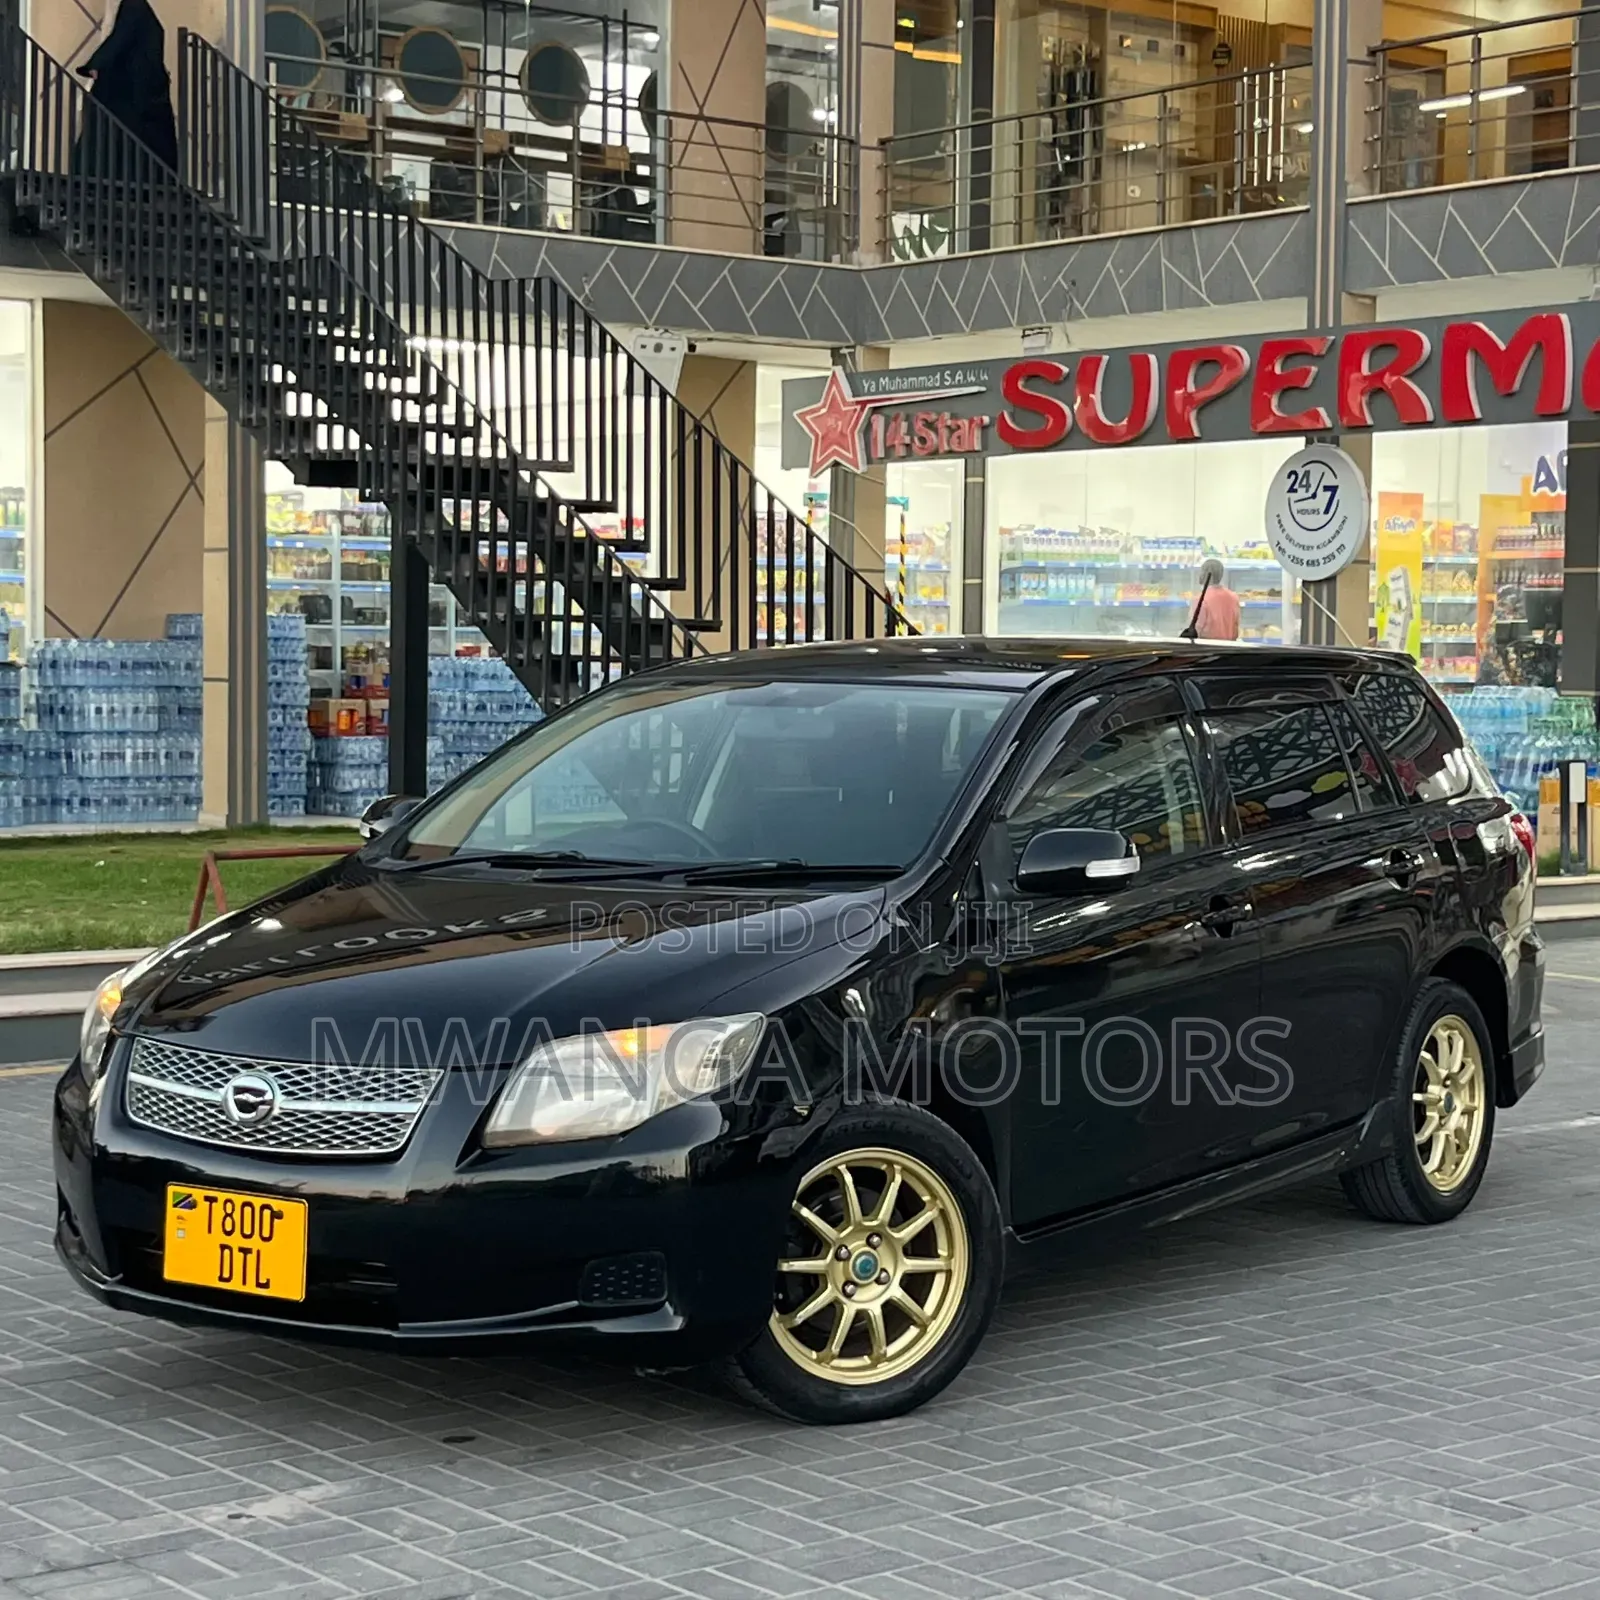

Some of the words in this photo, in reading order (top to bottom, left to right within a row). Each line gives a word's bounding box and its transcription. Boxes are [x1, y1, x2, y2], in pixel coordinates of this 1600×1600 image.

[862, 379, 876, 393] Ya
[879, 371, 941, 391] Muhammad
[995, 313, 1600, 448] SUPERM
[1275, 513, 1286, 534] FREE
[1285, 533, 1315, 551] DELIVERY
[1296, 507, 1321, 516] HOURS
[203, 1194, 276, 1242] T800
[217, 1243, 271, 1289] DTL
